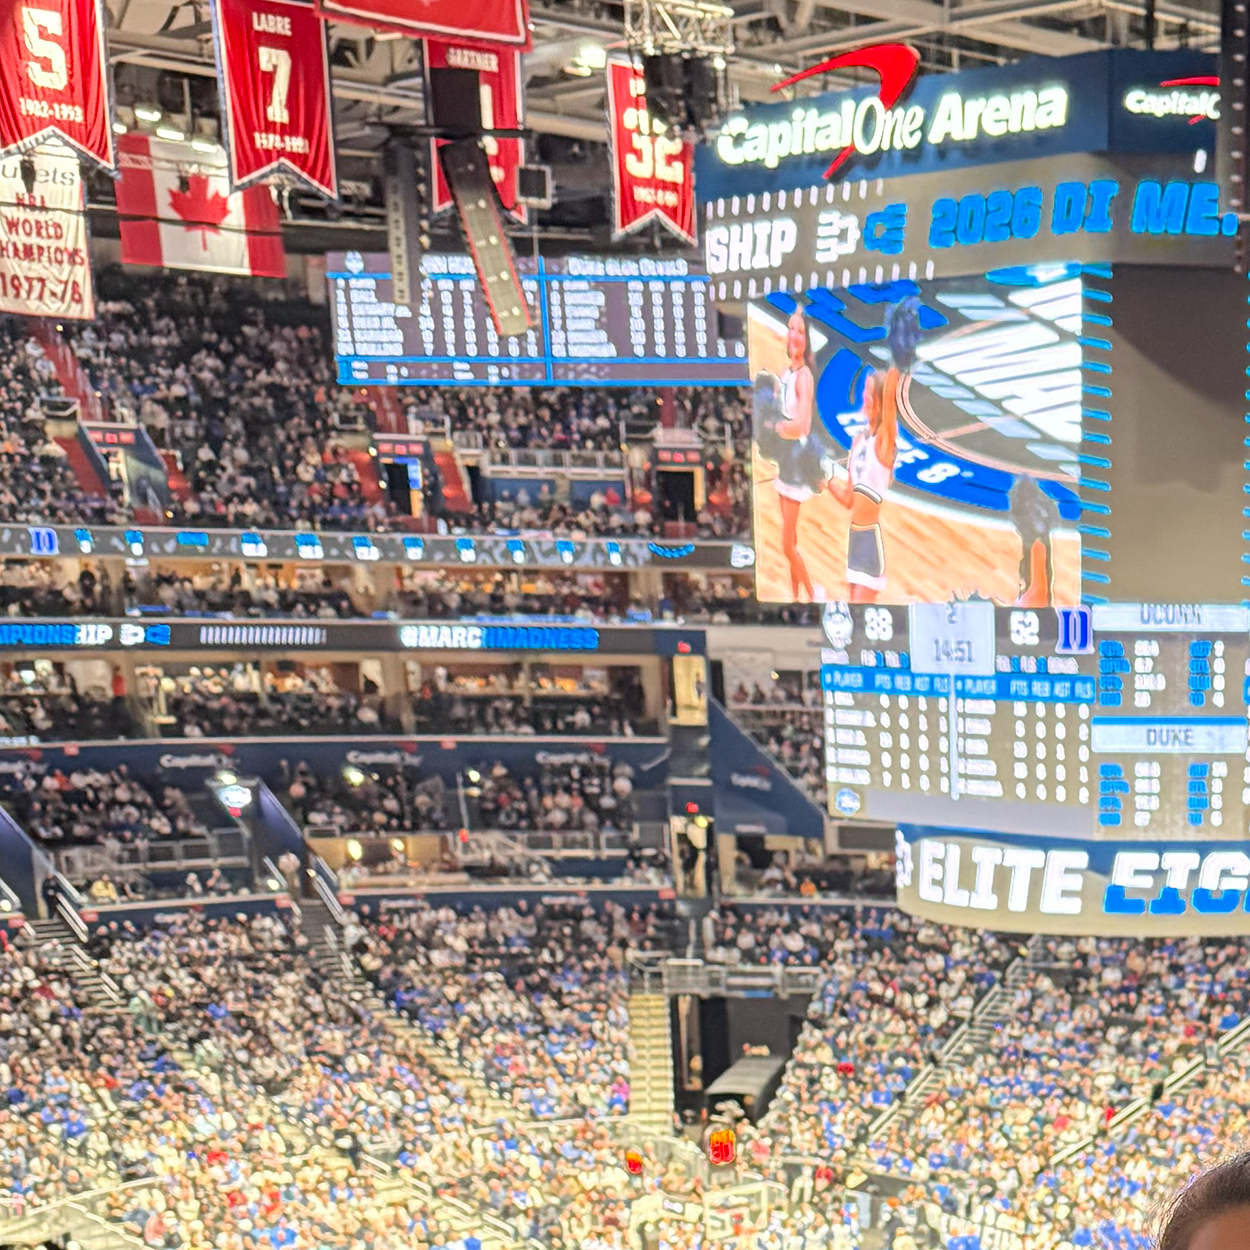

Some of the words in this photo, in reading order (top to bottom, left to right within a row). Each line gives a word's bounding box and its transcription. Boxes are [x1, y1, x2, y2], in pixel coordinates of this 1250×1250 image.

[22, 7, 68, 91] 5
[252, 11, 293, 36] LABRE
[258, 47, 292, 124] 7
[928, 86, 1068, 145] Arena
[4, 216, 64, 240] WORLD
[706, 217, 797, 274] SHIP
[929, 187, 1043, 249] 2026
[1051, 179, 1119, 235] DI
[1130, 179, 1239, 236] ME
[0, 246, 85, 268] HAMPIONS
[1146, 727, 1194, 747] DUKE
[919, 836, 1089, 915] ELITE
